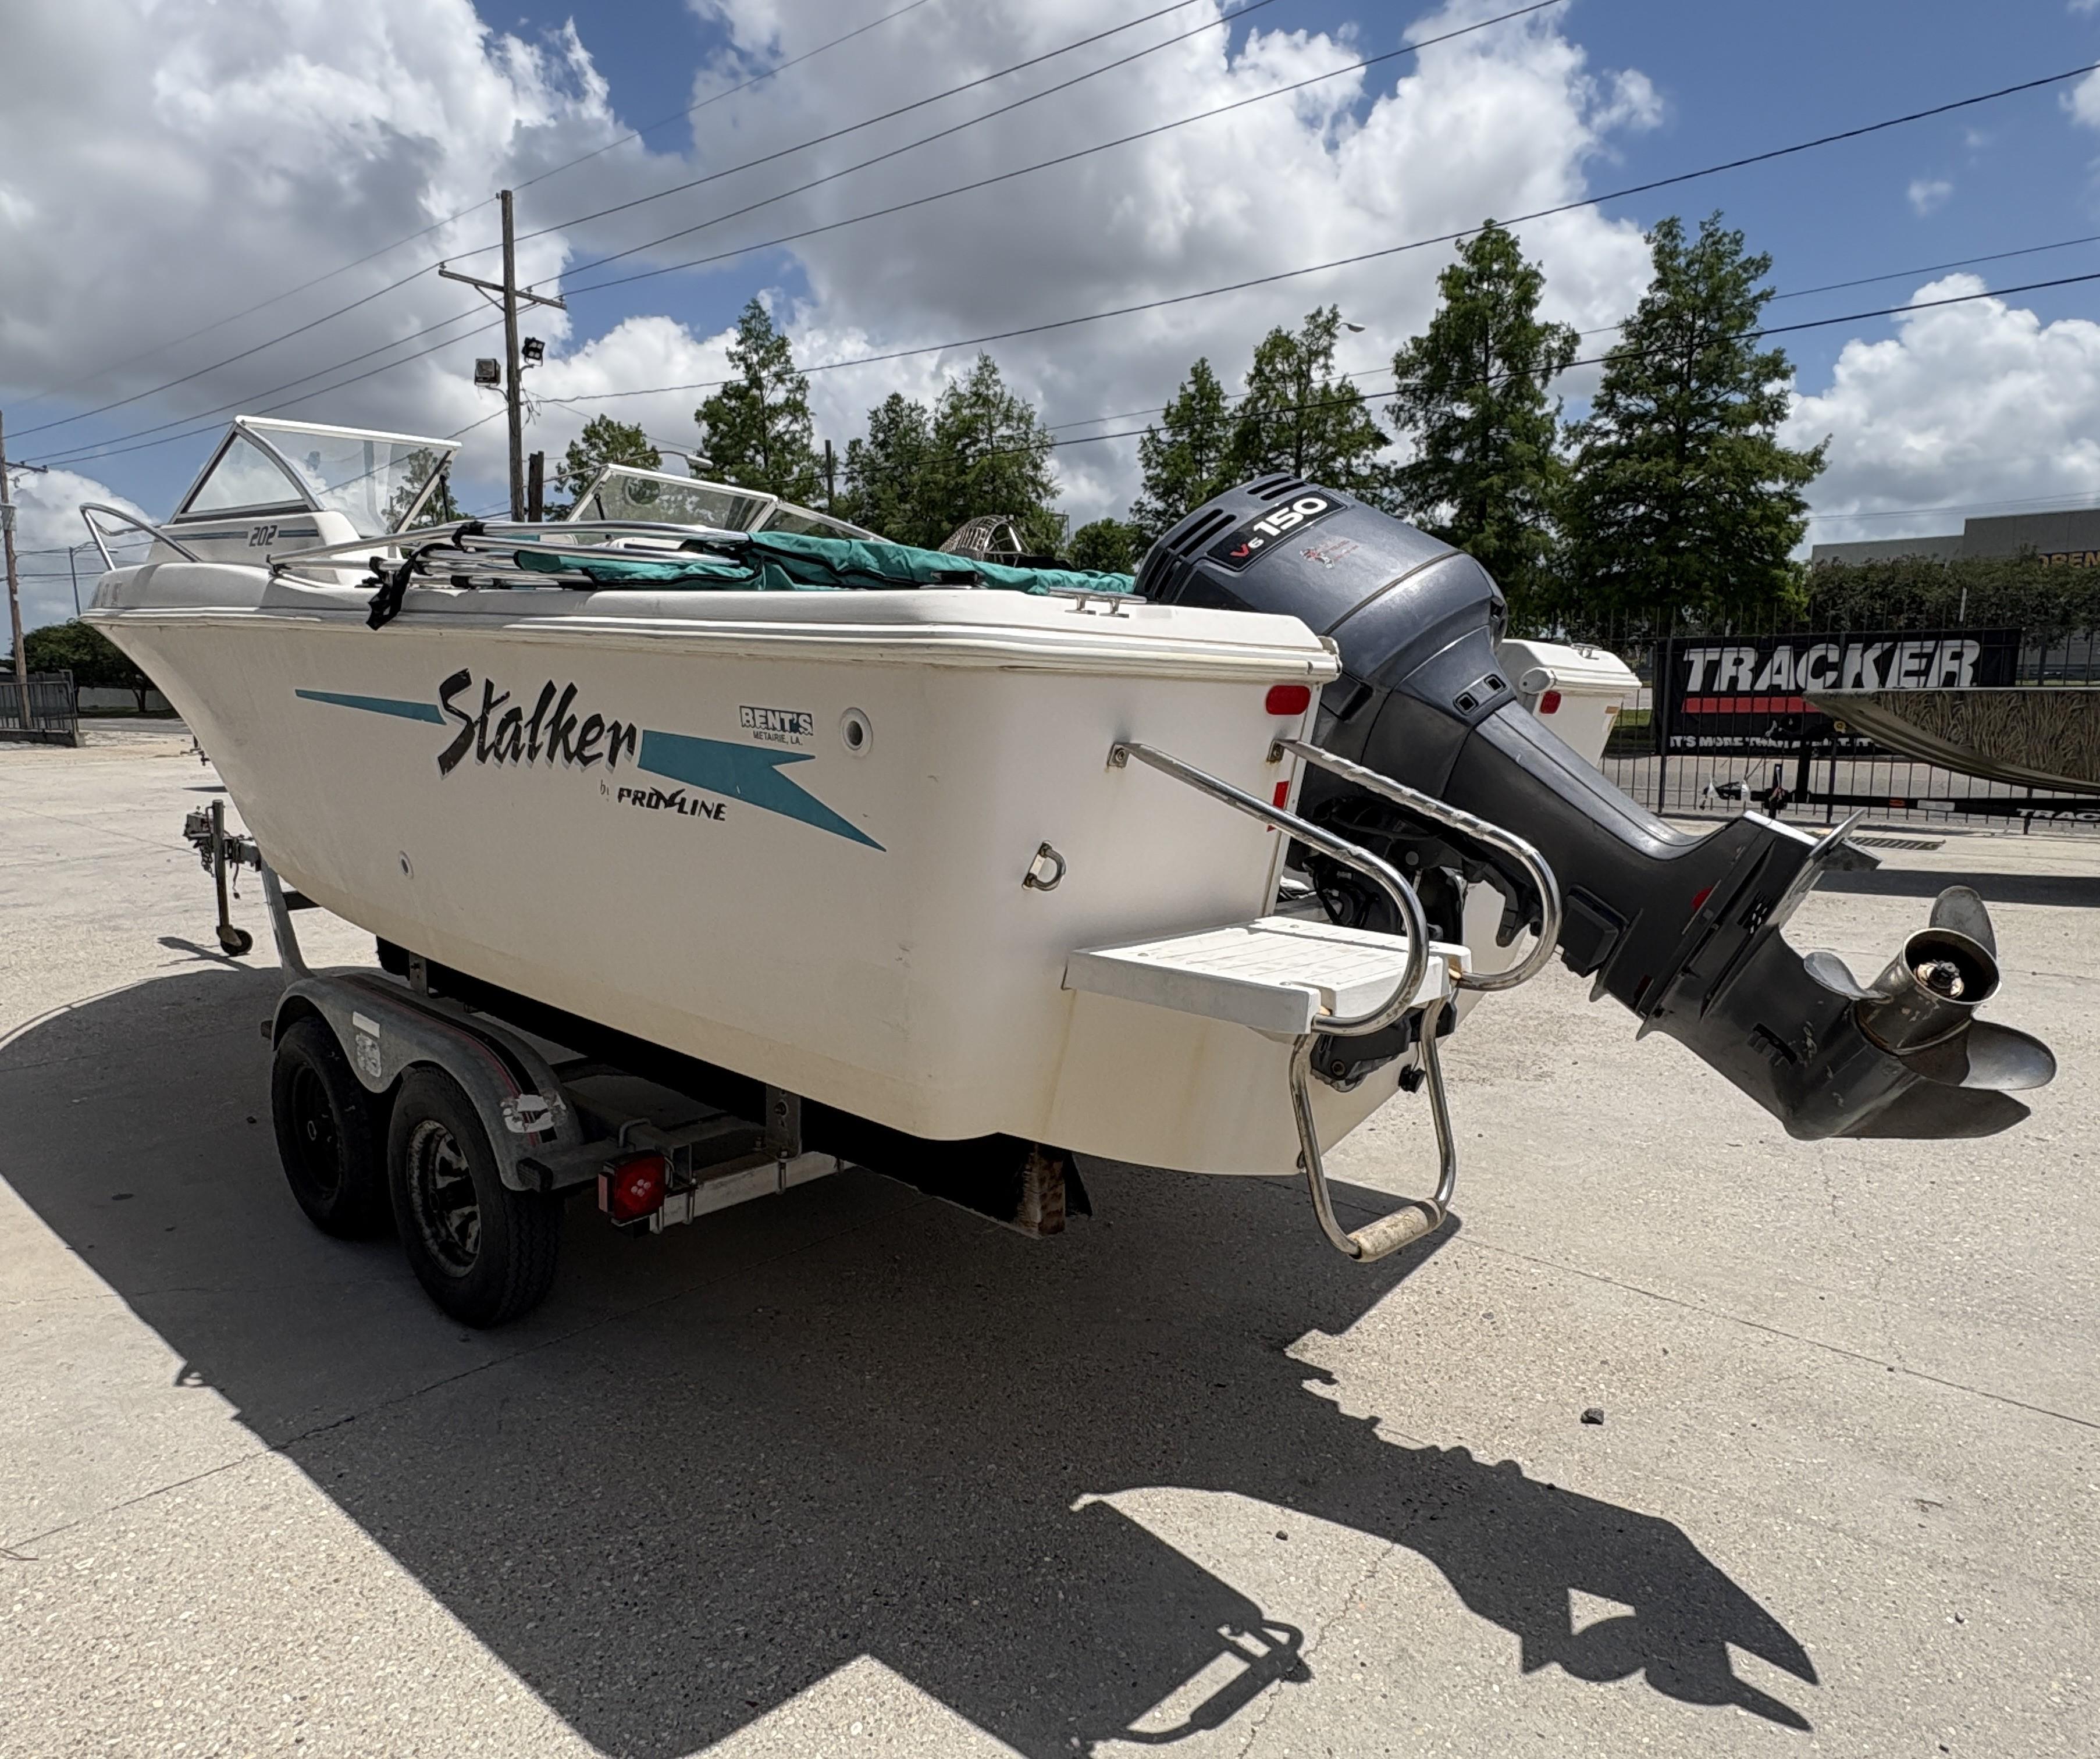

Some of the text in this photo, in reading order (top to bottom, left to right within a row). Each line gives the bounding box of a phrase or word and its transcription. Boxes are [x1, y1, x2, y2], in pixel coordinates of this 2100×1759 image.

[249, 525, 278, 547] 202
[1230, 498, 1327, 557] V6 150
[1683, 640, 1980, 692] TRACKER
[438, 668, 637, 777] Stalker
[741, 707, 813, 734] BENT'S
[753, 731, 789, 745] METAIRIE,
[1670, 735, 1697, 748] IT'S
